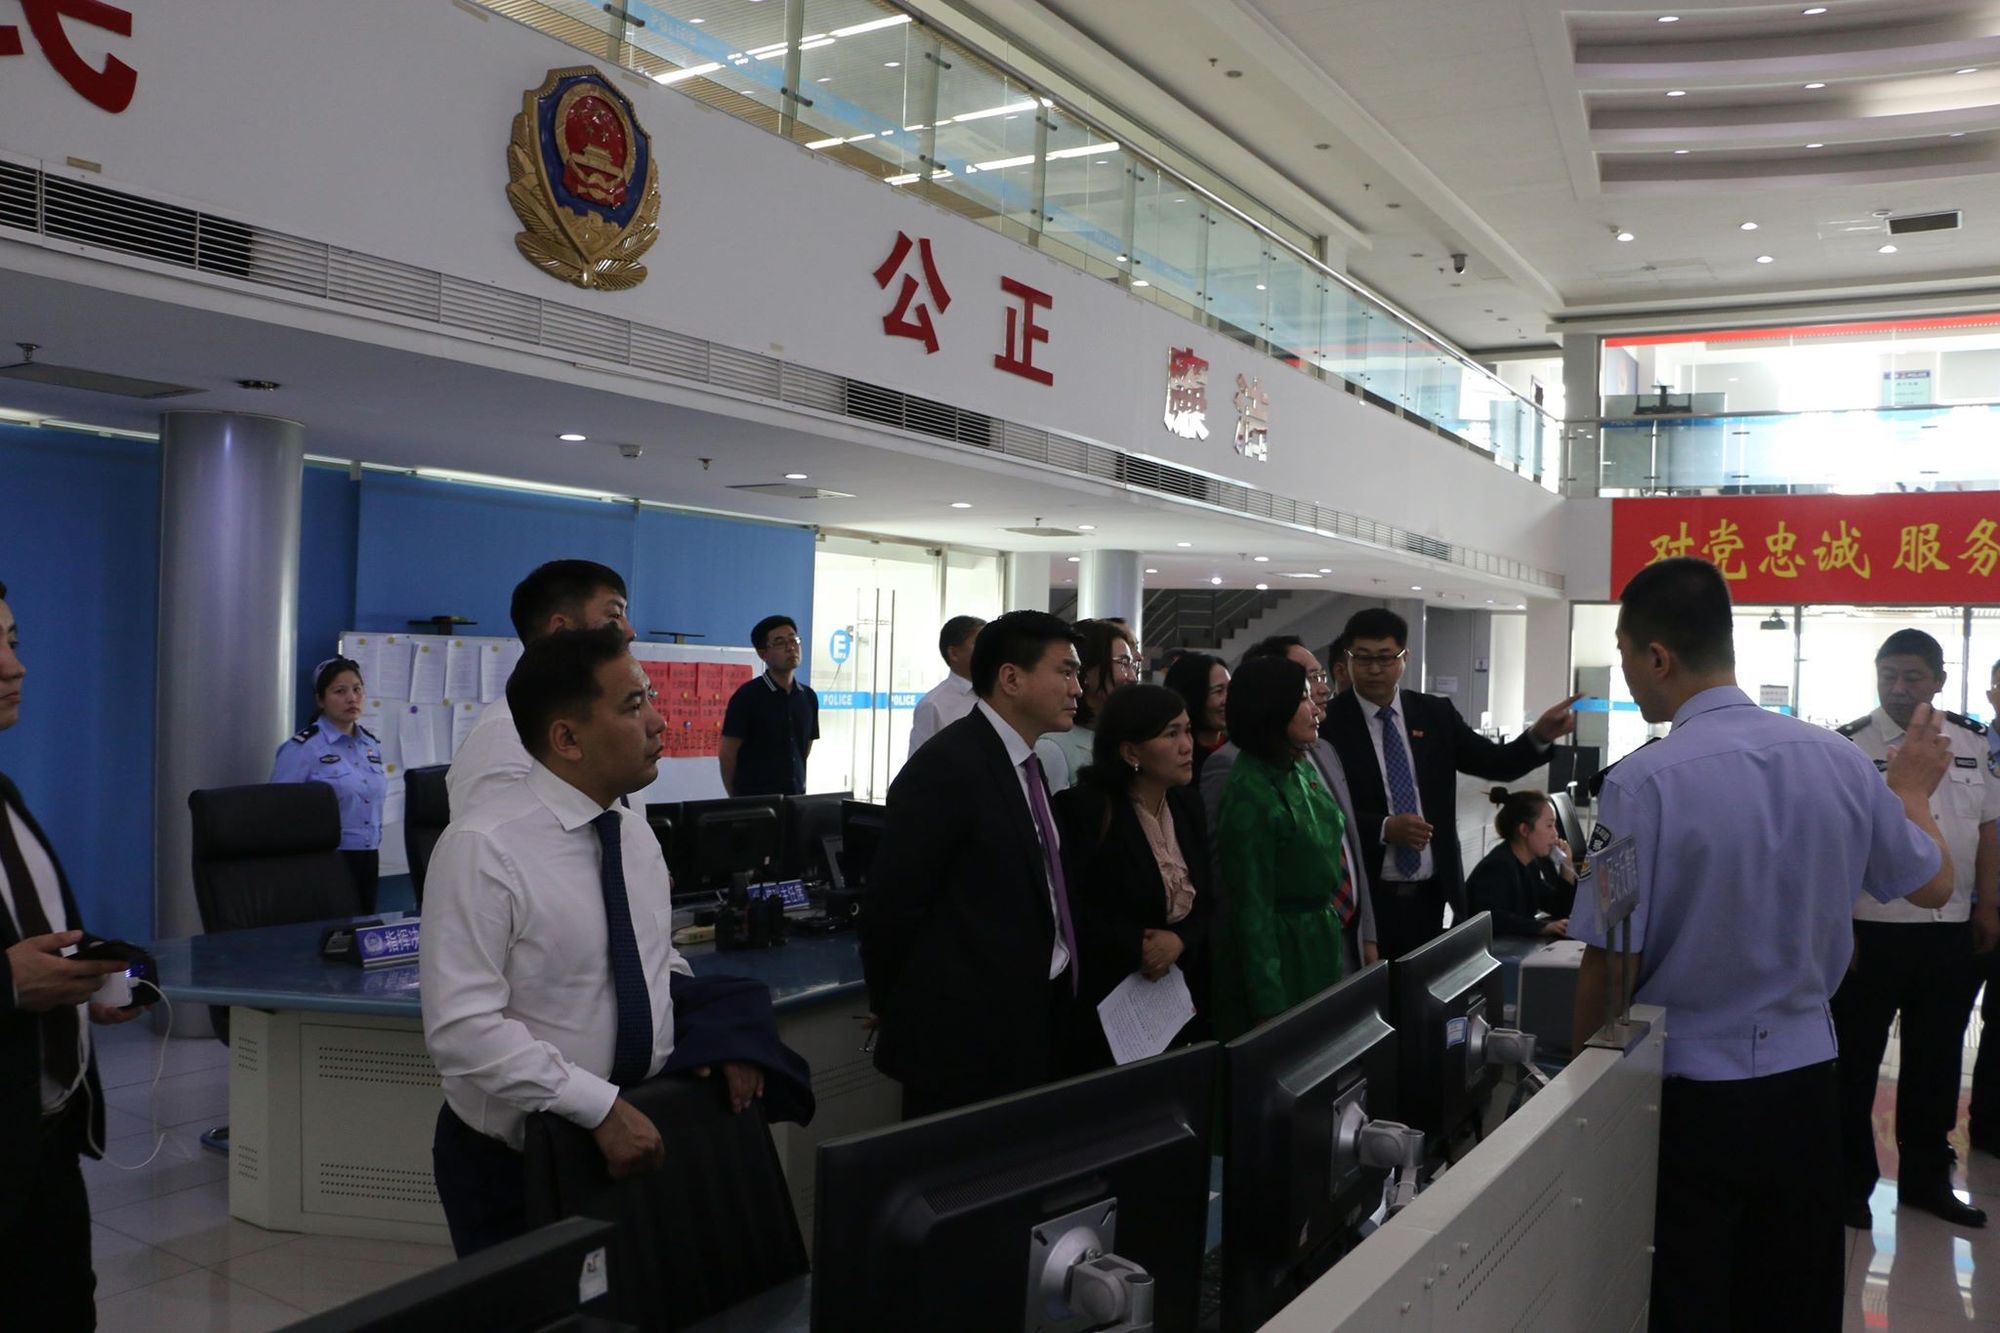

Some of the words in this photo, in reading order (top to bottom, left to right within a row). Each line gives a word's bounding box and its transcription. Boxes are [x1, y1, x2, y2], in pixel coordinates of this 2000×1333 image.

[1643, 518, 1872, 580] 对党忠诚
[1892, 518, 2000, 577] 服务
[823, 694, 852, 706] POLICE
